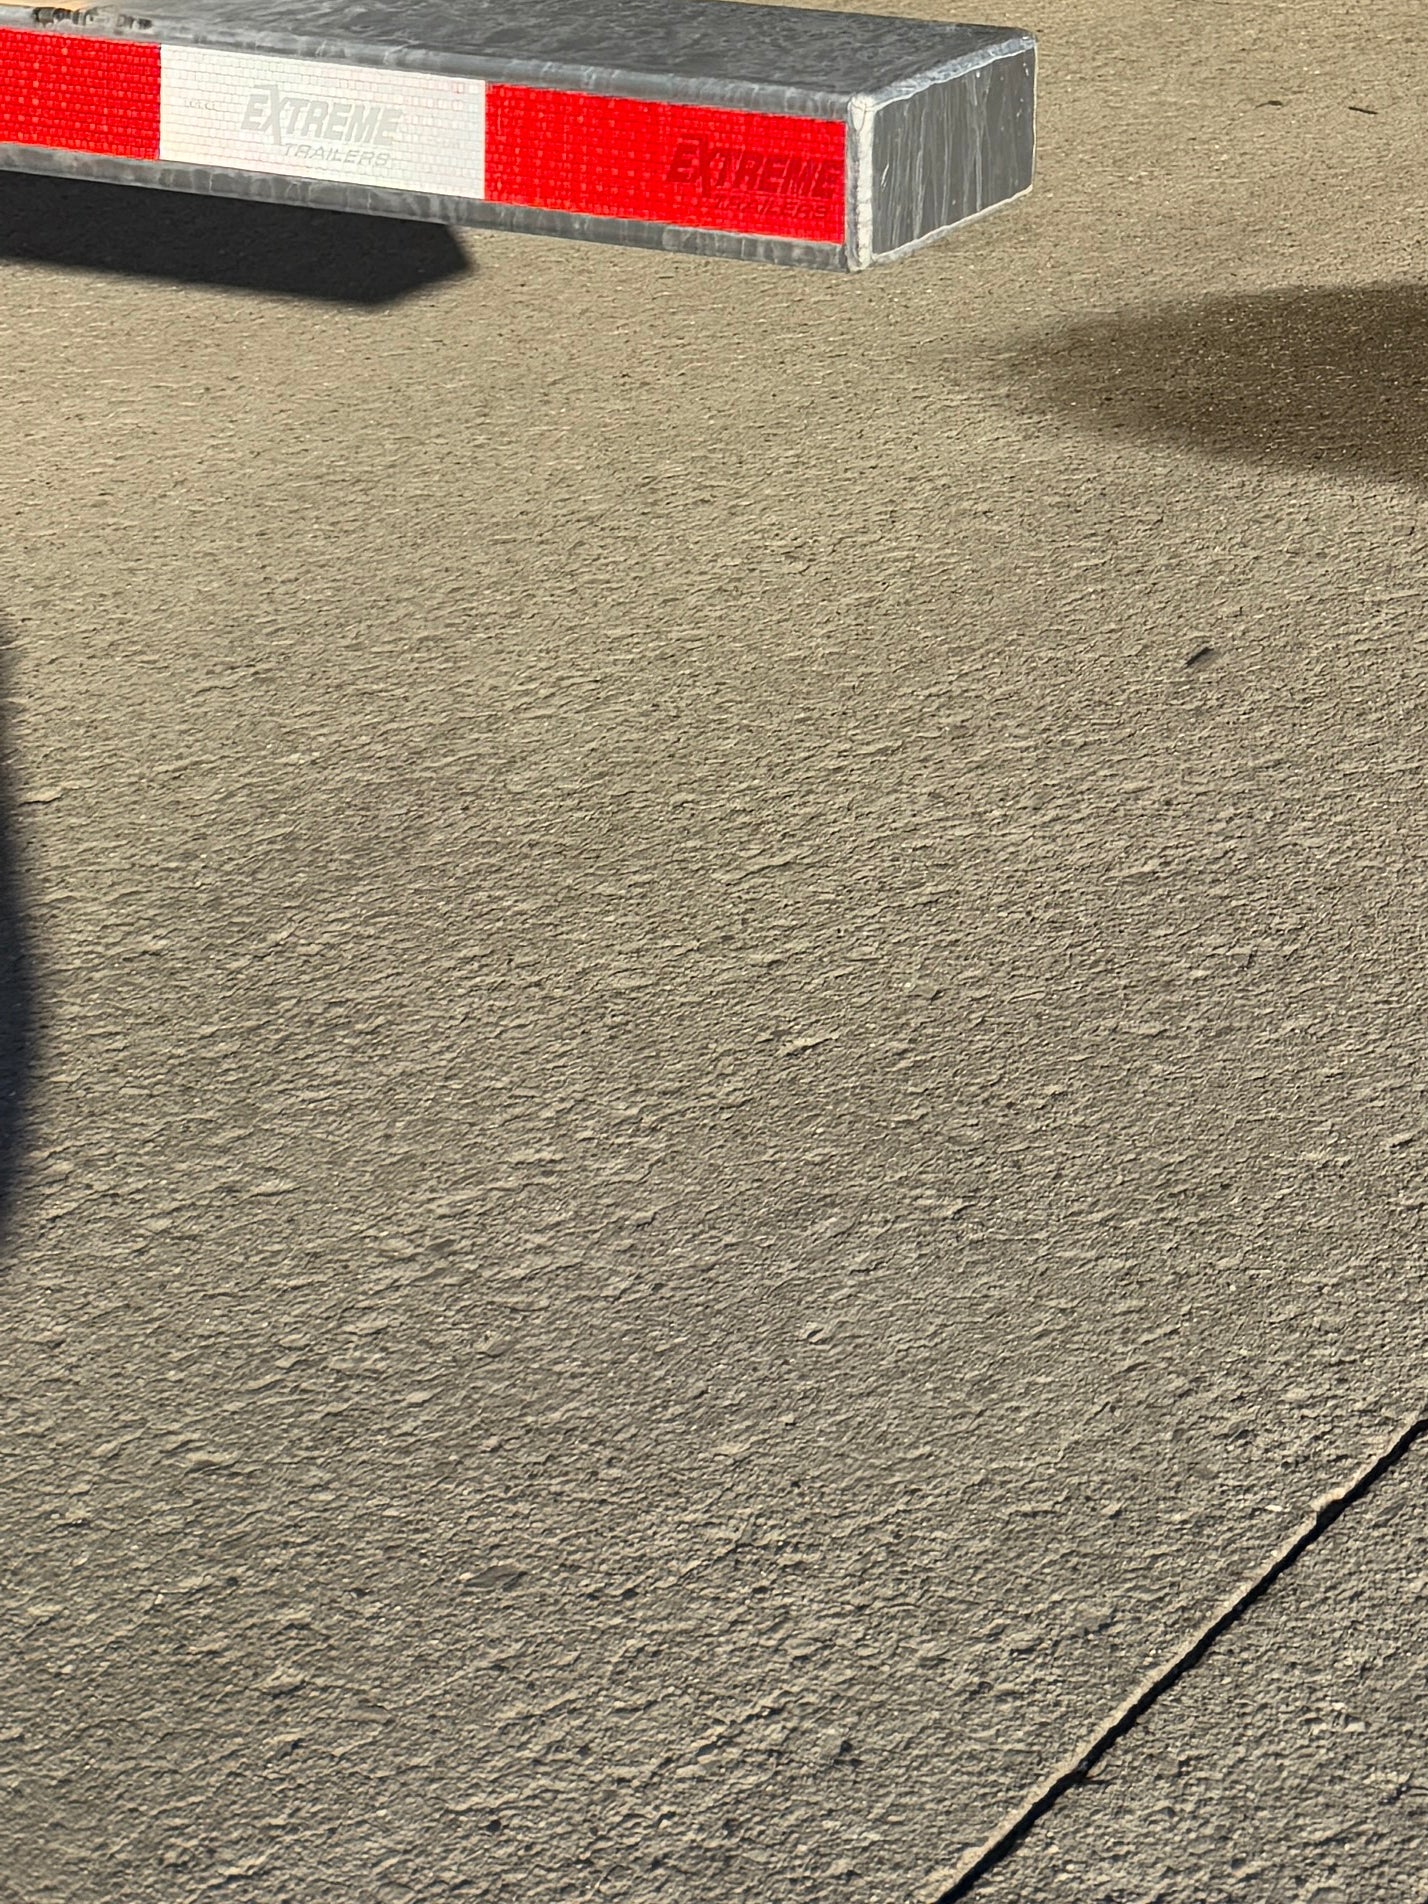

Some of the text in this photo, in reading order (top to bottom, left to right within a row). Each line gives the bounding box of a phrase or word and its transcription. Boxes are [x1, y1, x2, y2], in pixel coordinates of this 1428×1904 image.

[240, 84, 402, 146] EXTREME
[282, 142, 392, 167] TRAILERS
[666, 133, 845, 199] EXTREME
